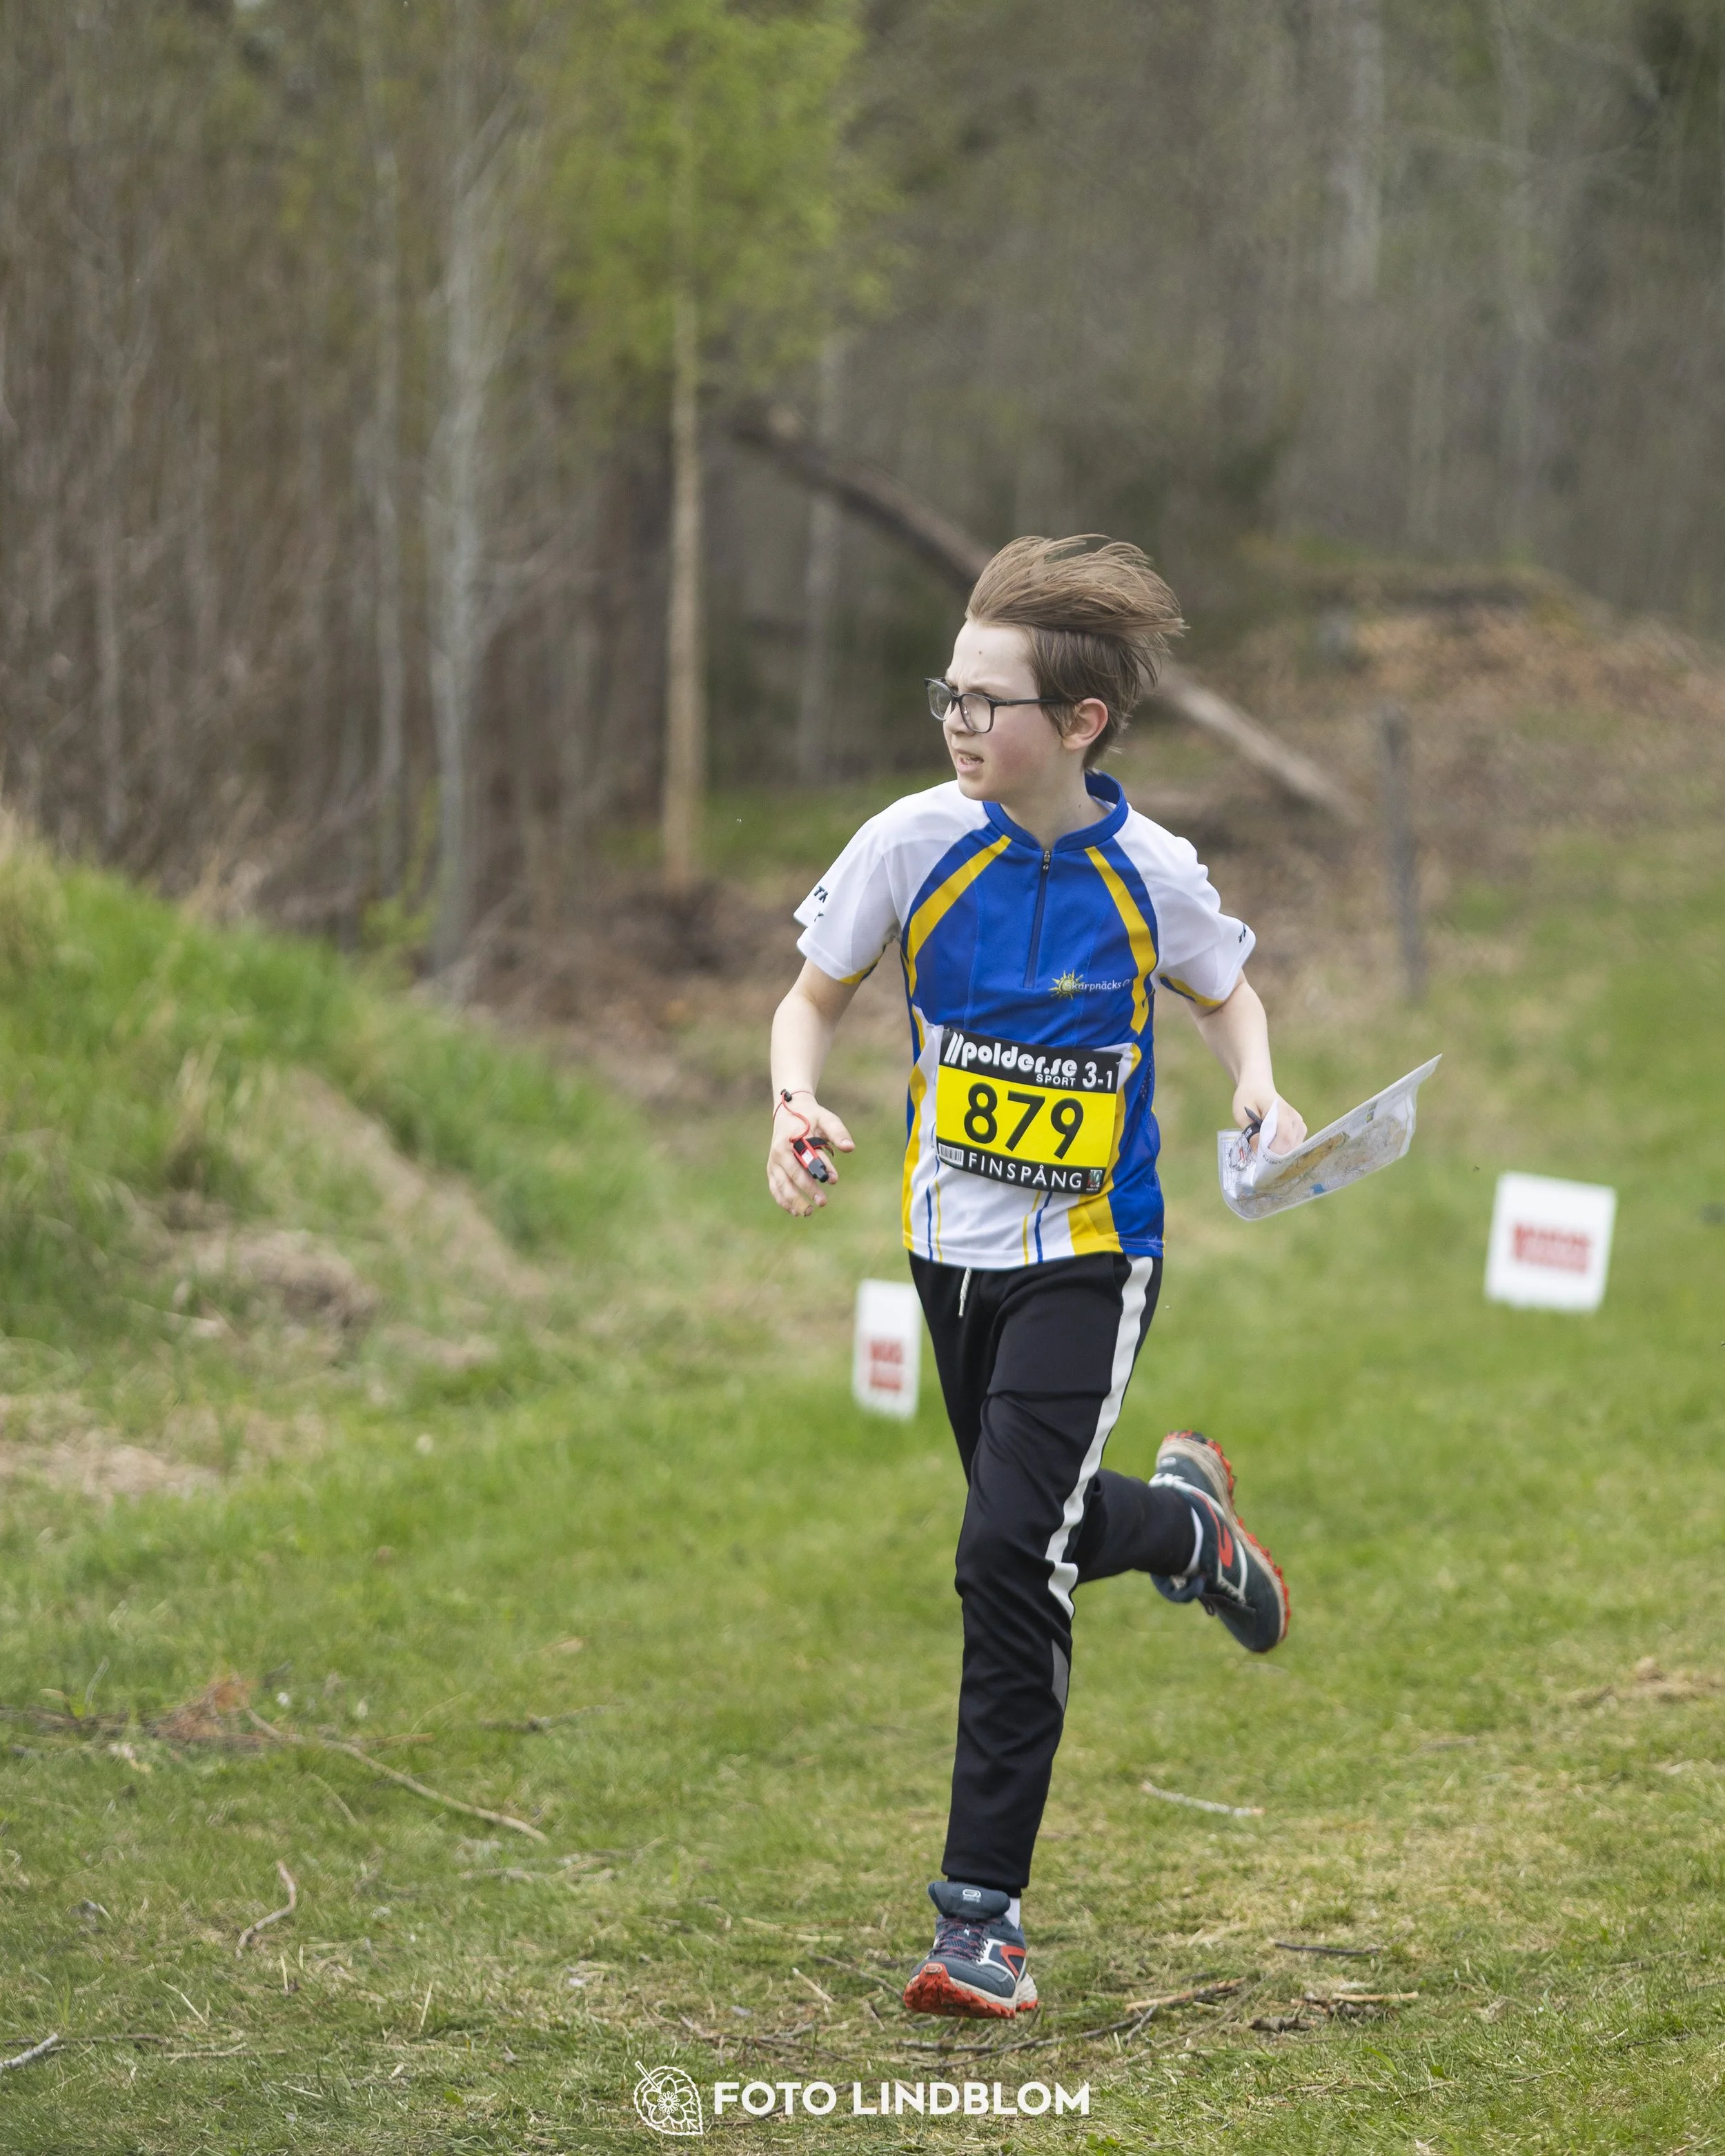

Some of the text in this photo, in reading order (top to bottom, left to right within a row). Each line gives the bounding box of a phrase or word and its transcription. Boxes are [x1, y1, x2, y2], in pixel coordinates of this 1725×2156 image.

[1036, 1073, 1076, 1087] SPORT
[1082, 1061, 1113, 1089] 3-1
[964, 1082, 1084, 1160] 879
[969, 1151, 1083, 1190] FINSPÅNG
